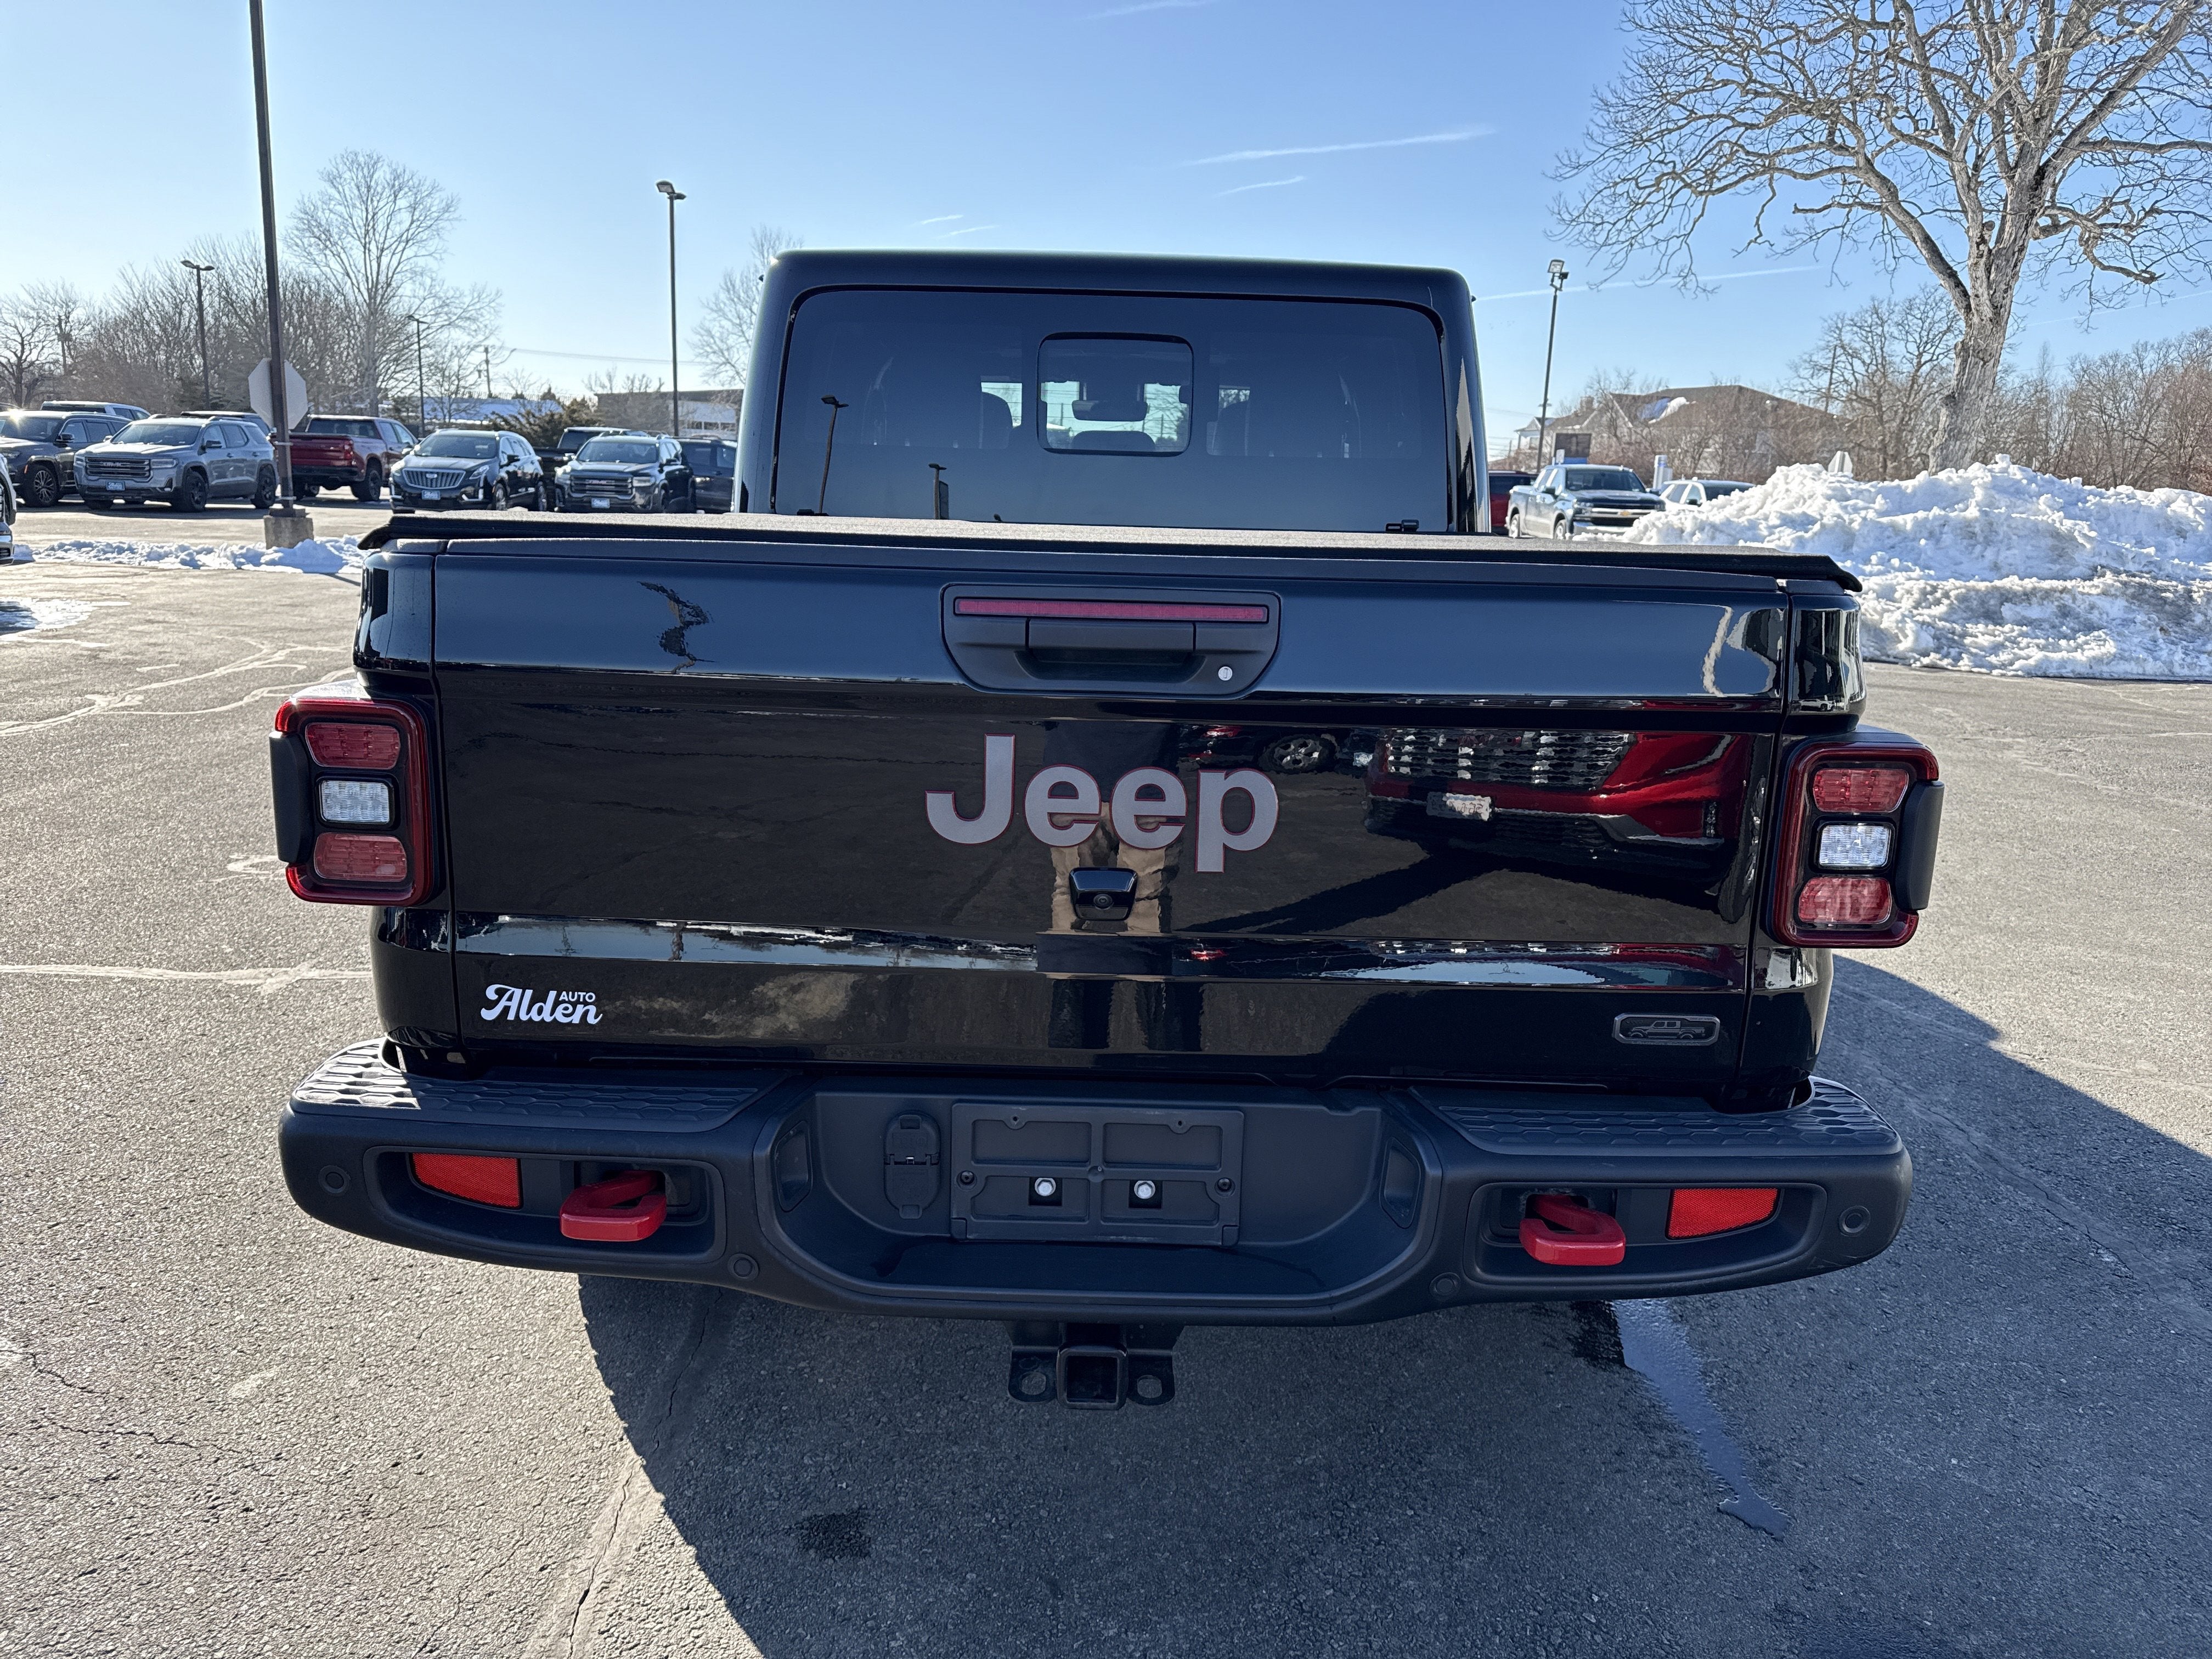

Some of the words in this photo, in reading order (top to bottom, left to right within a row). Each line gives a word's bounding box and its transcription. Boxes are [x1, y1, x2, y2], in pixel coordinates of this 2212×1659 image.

[925, 733, 1279, 873] Jeep
[481, 984, 603, 1025] Alden
[558, 991, 596, 1003] AUTO
